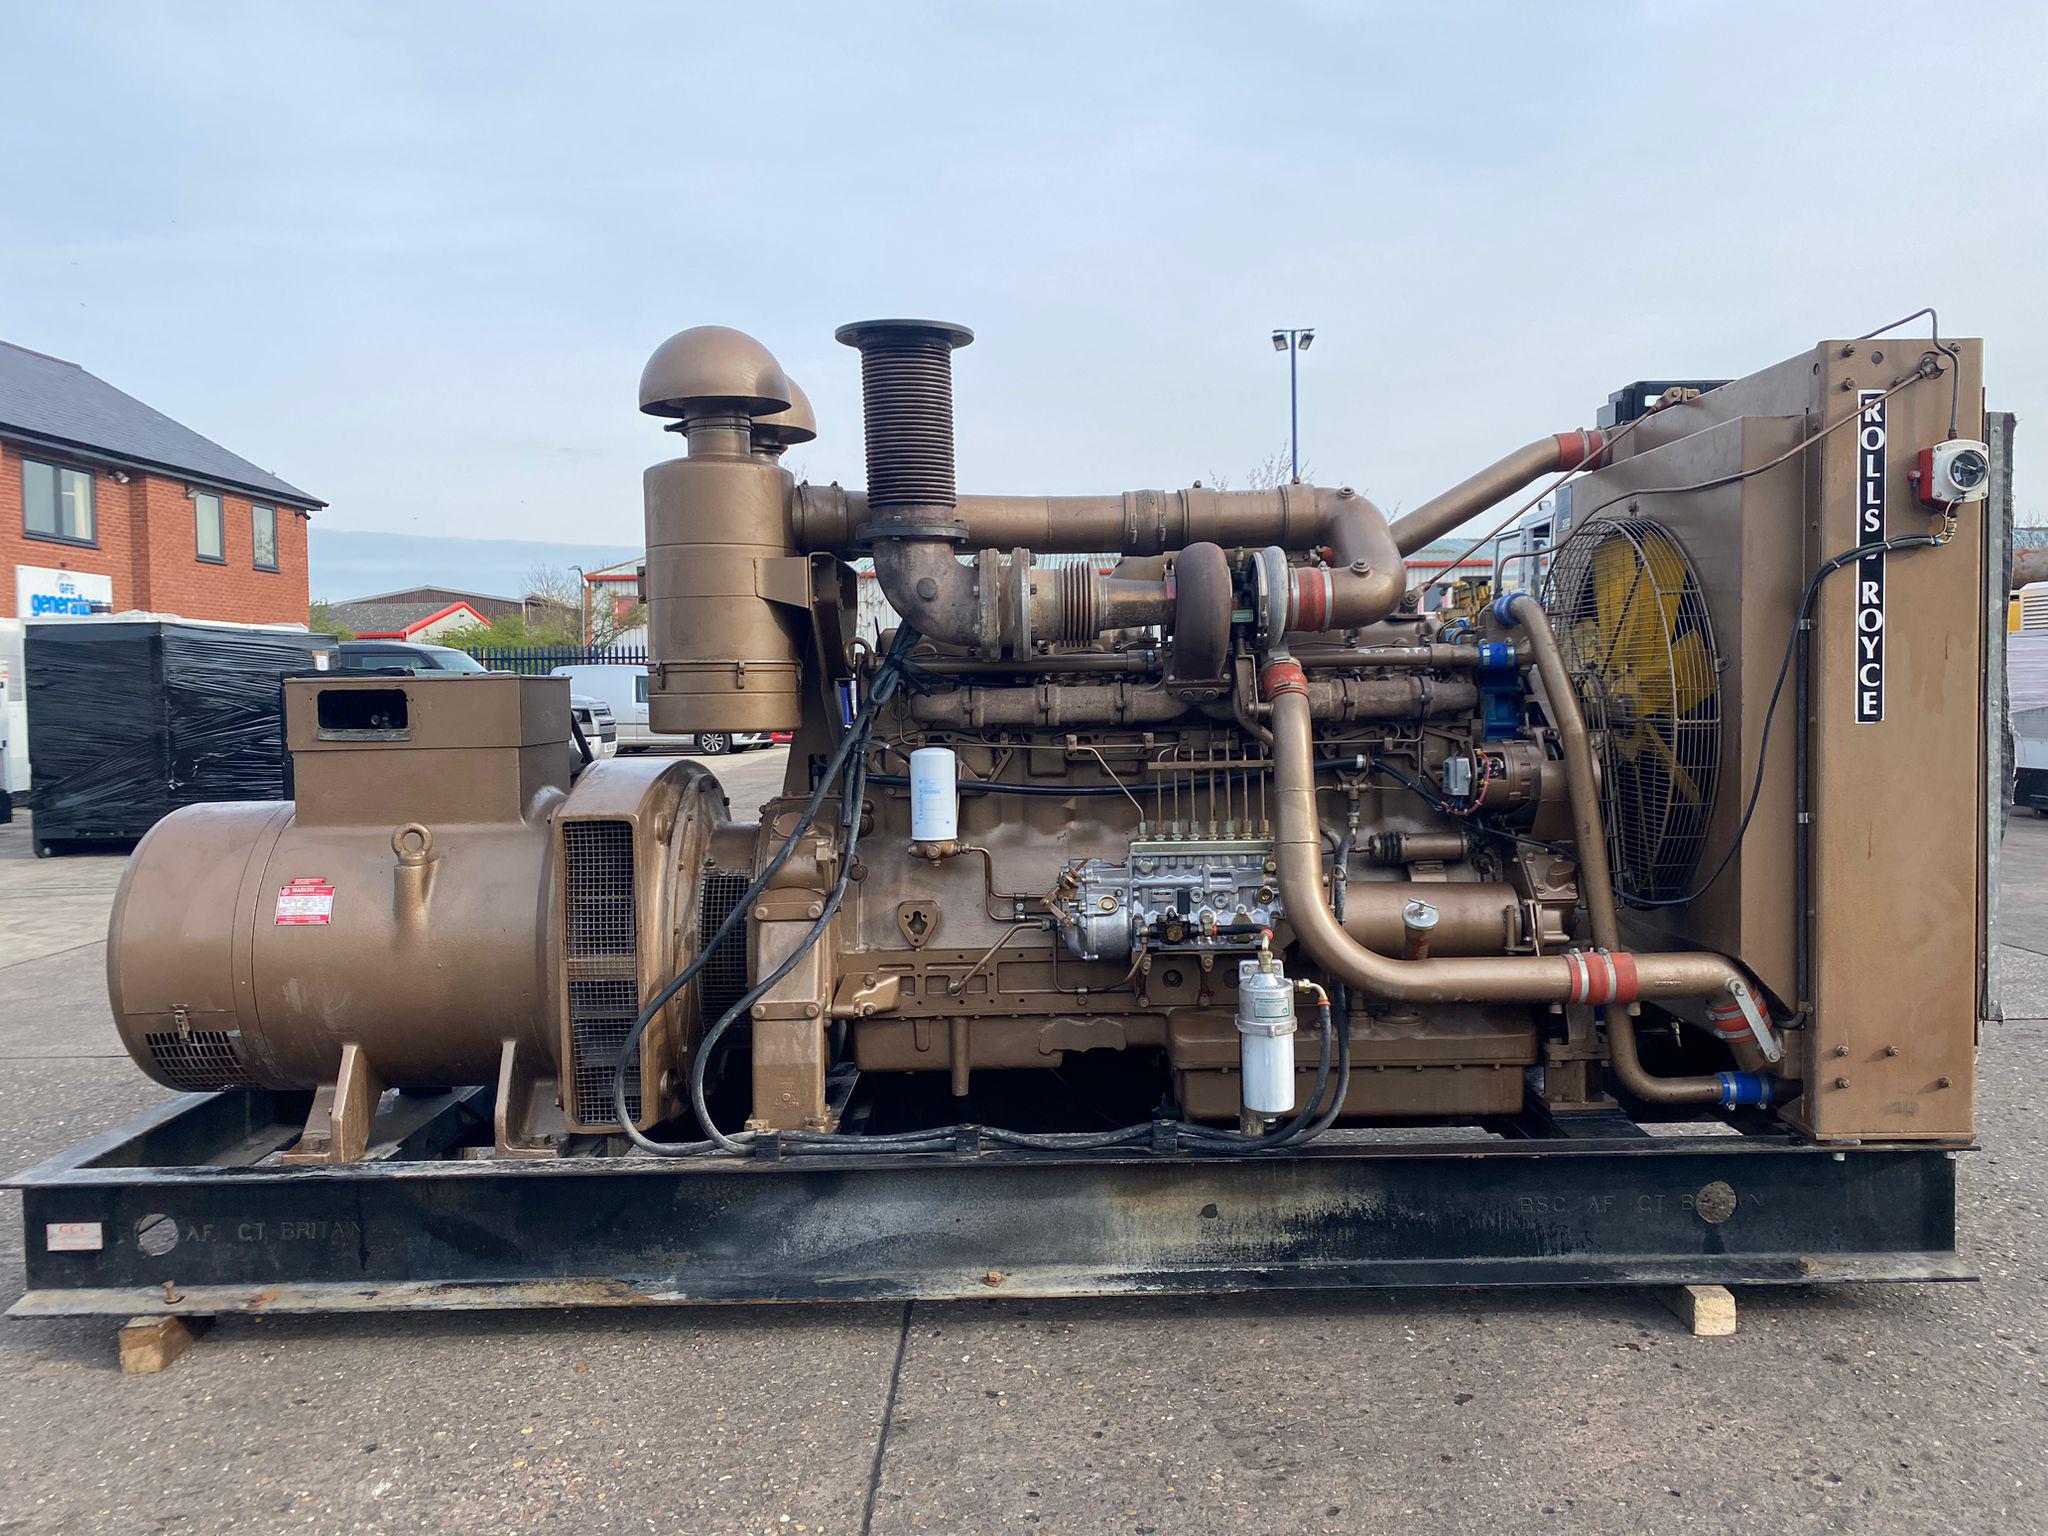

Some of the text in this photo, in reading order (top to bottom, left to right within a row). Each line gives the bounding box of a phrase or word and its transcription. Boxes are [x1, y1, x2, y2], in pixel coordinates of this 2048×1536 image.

[32, 594, 103, 616] generato
[1859, 399, 1885, 714] ROLLS ROYCE
